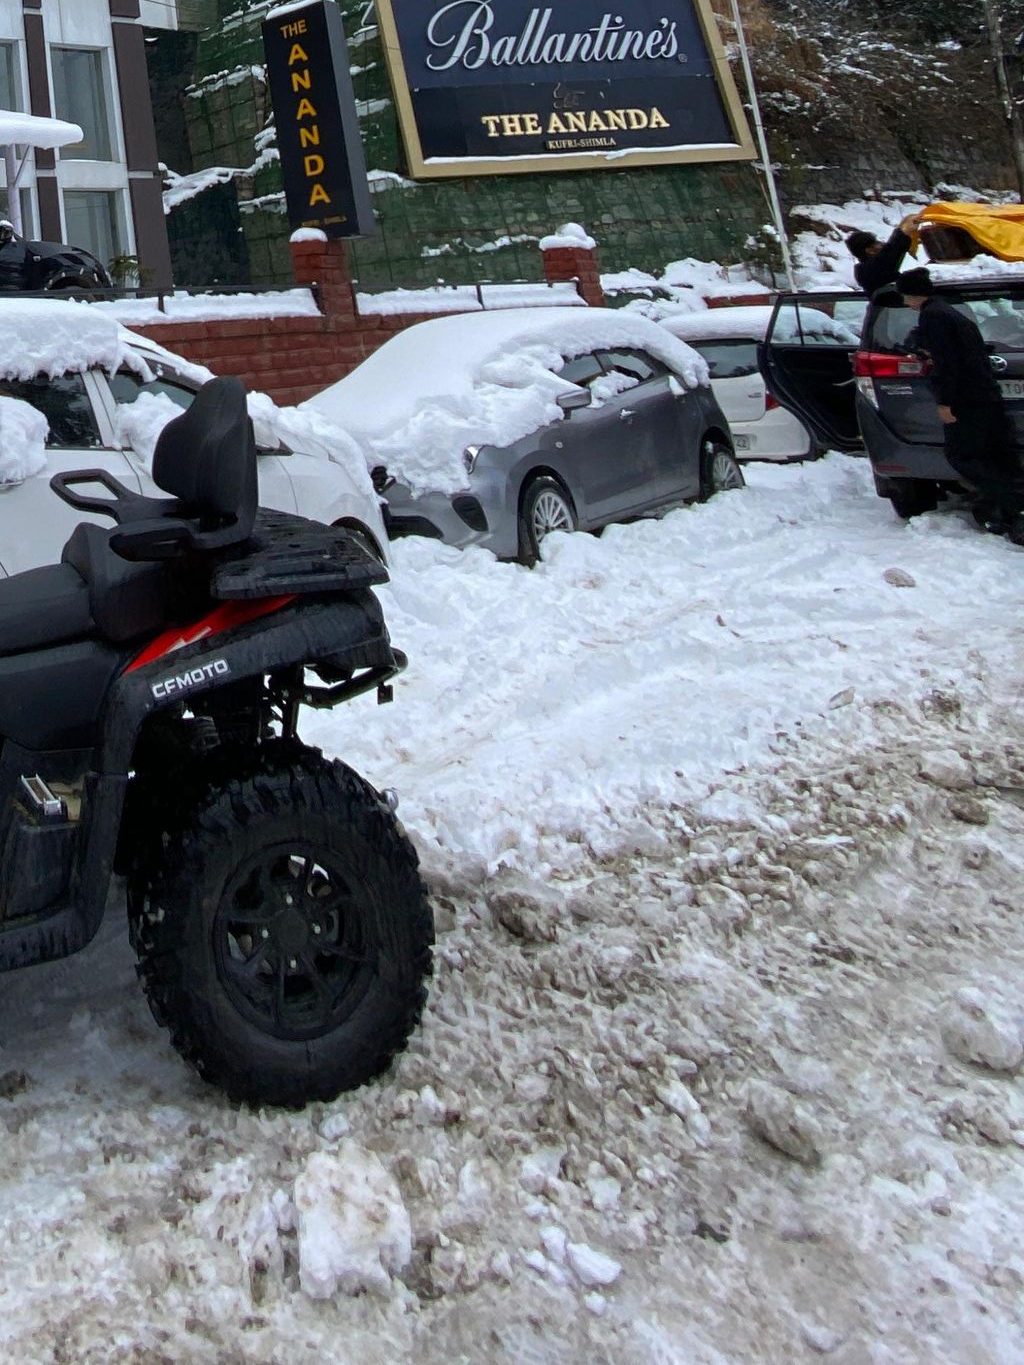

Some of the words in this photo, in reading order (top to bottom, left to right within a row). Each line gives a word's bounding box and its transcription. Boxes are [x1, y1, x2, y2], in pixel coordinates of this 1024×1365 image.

[280, 19, 308, 39] THE
[288, 42, 332, 207] ANANDA
[481, 112, 543, 137] THE
[546, 107, 671, 134] ANANDA
[547, 137, 617, 151] KUFRI-SHIMLA
[151, 659, 229, 698] CFMOTO
